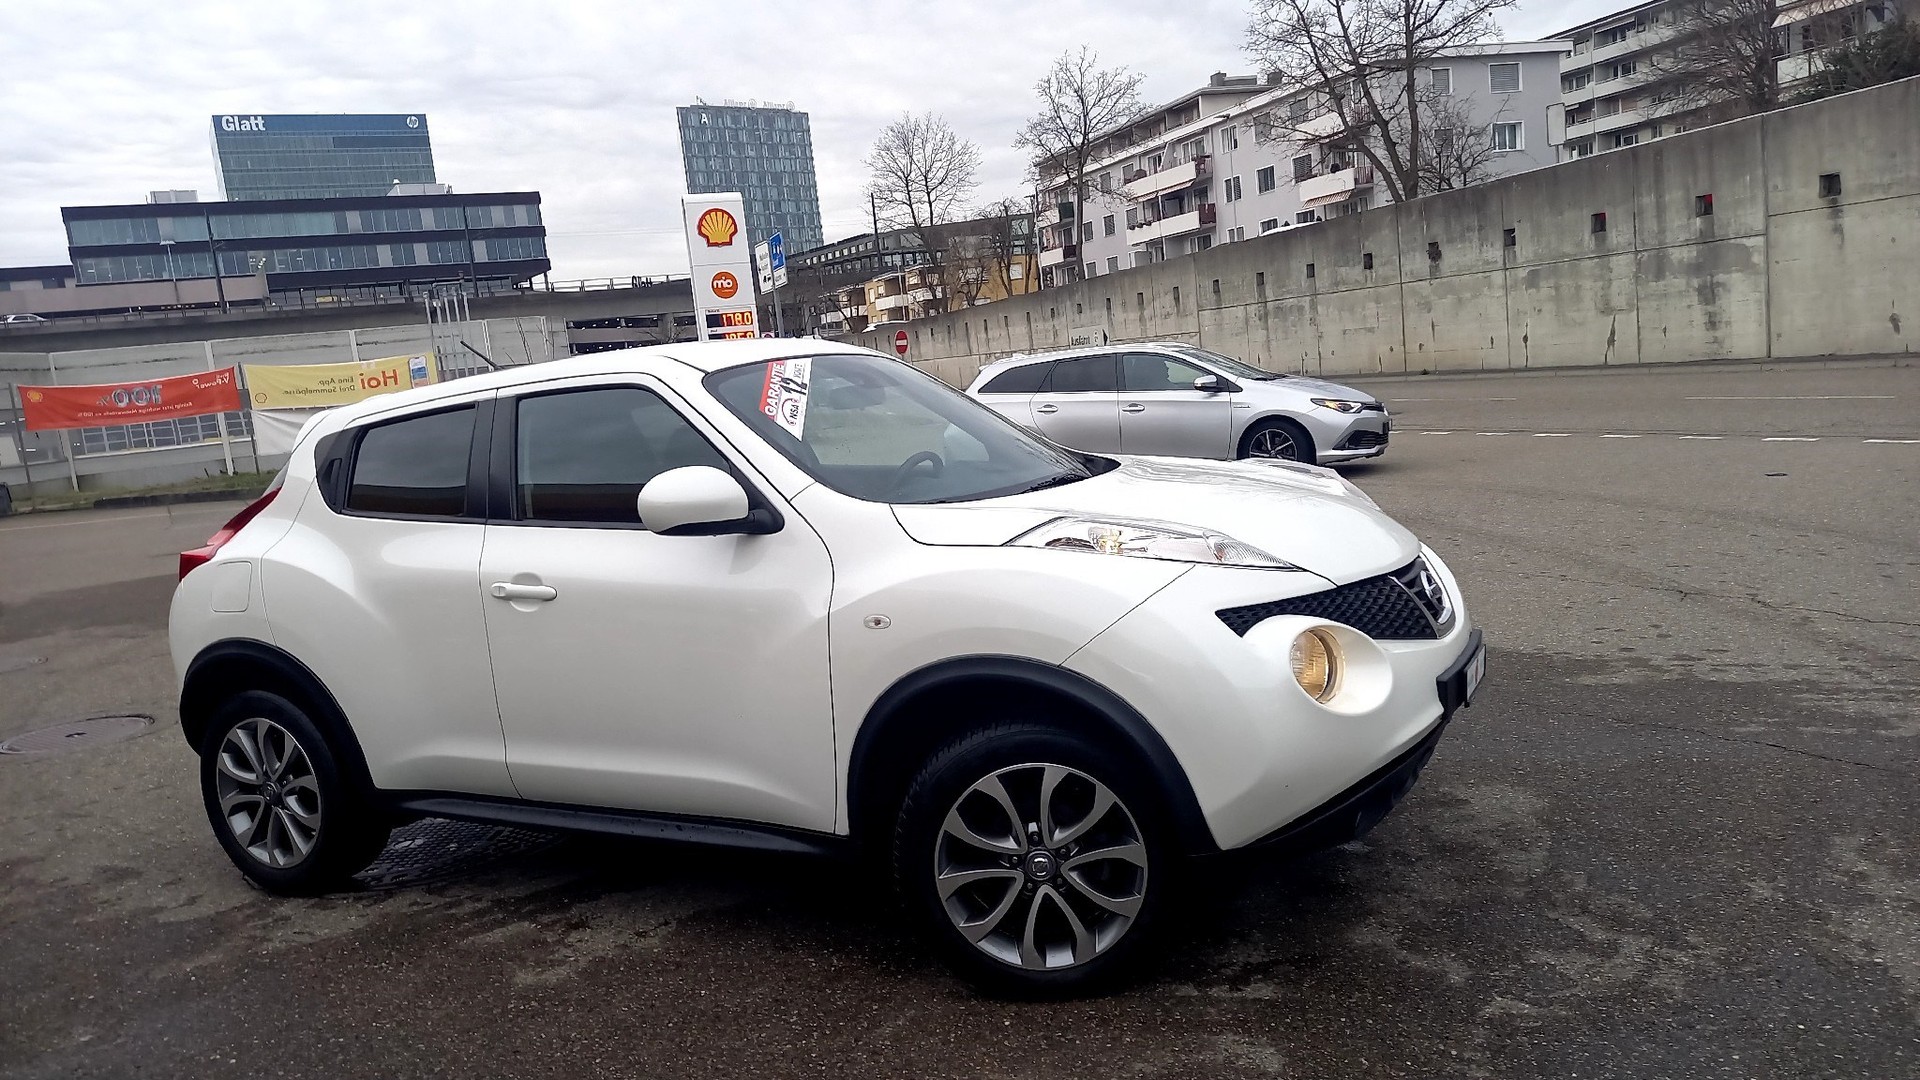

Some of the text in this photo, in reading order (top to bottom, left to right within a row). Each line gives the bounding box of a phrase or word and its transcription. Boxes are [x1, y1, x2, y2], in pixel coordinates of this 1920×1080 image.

[221, 115, 266, 131] Glatt
[406, 115, 419, 129] hp
[723, 312, 752, 326] 178.0
[764, 362, 784, 416] GARANTIE
